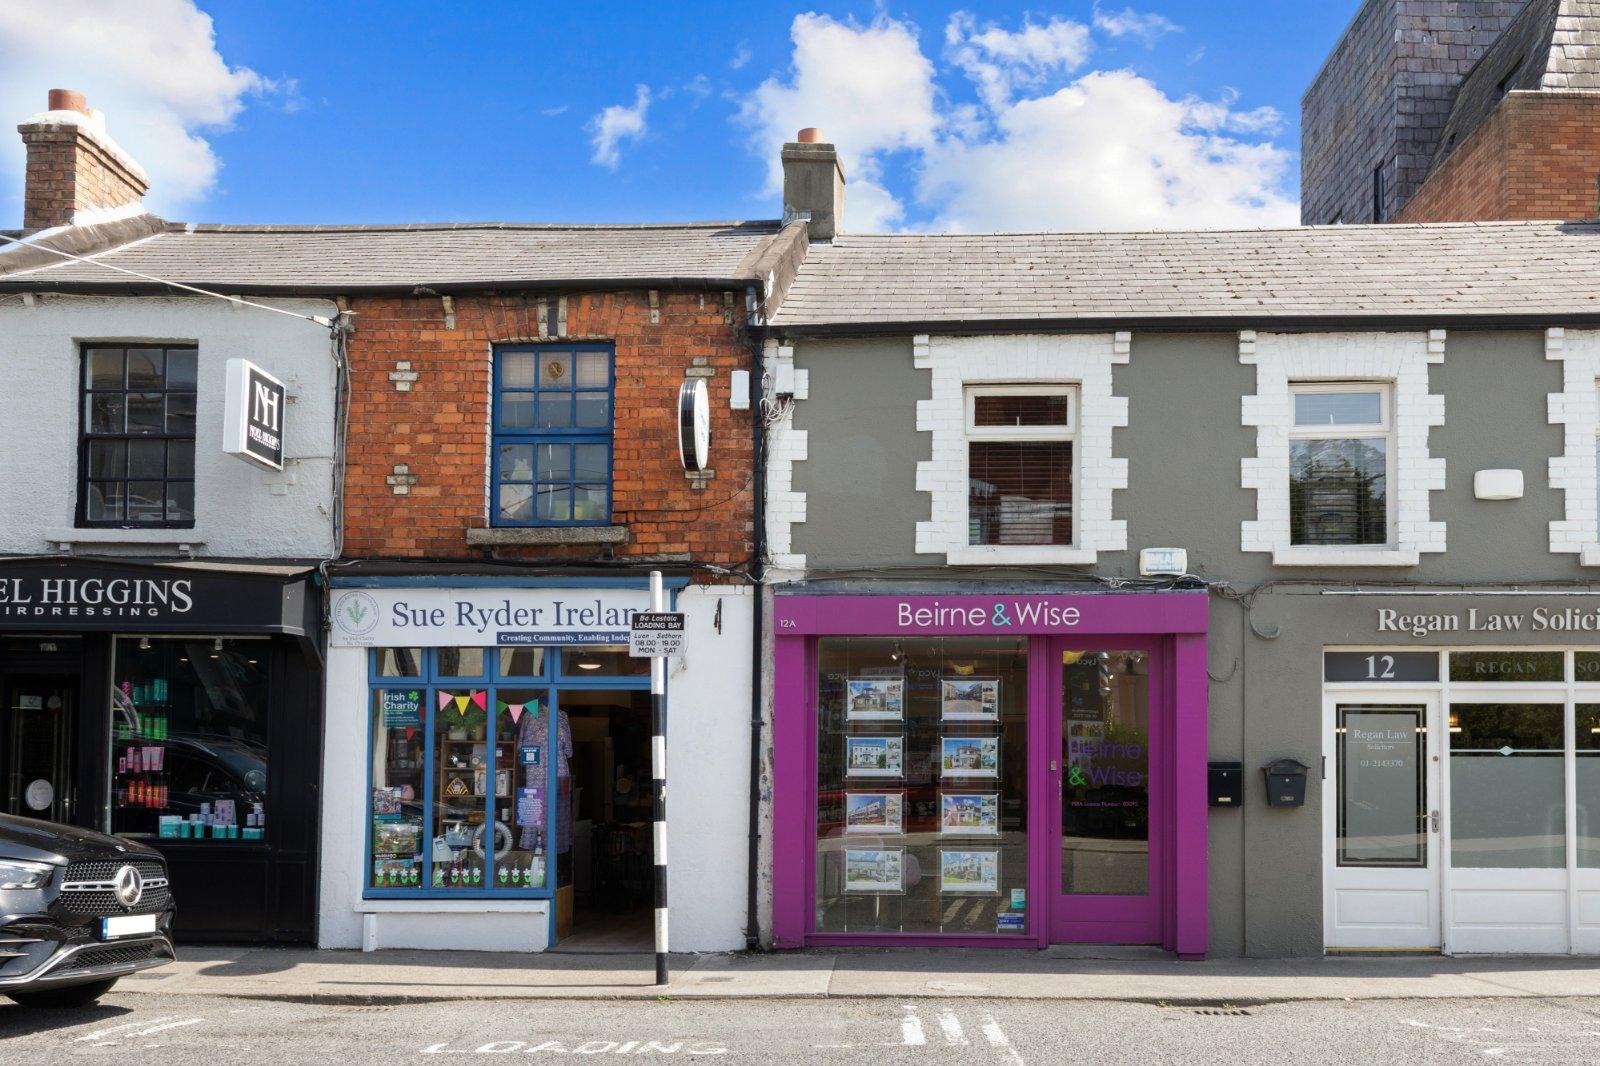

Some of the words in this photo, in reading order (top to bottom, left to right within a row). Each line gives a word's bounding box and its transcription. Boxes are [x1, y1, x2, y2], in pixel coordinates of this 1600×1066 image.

[40, 578, 193, 613] HIGGINS
[5, 606, 159, 616] IRDRESSING
[392, 601, 446, 627] Sue
[455, 599, 544, 634] Ryder
[552, 599, 650, 627] Irelan
[898, 601, 987, 626] Beirne
[991, 603, 1013, 626] &
[1014, 601, 1081, 626] Wise
[780, 619, 797, 628] 12A
[1377, 608, 1459, 637] Regan
[1468, 608, 1524, 631] Law
[1532, 607, 1600, 631] Solici
[501, 634, 532, 643] Creating
[533, 634, 577, 643] Community,
[578, 634, 610, 643] Enabling
[1364, 655, 1395, 679] 12
[1475, 661, 1537, 673] REGAN
[383, 693, 405, 701] Irish
[383, 702, 418, 712] Charity
[1353, 729, 1384, 741] Regan
[1387, 729, 1408, 739] Law
[1087, 764, 1142, 786] Wise
